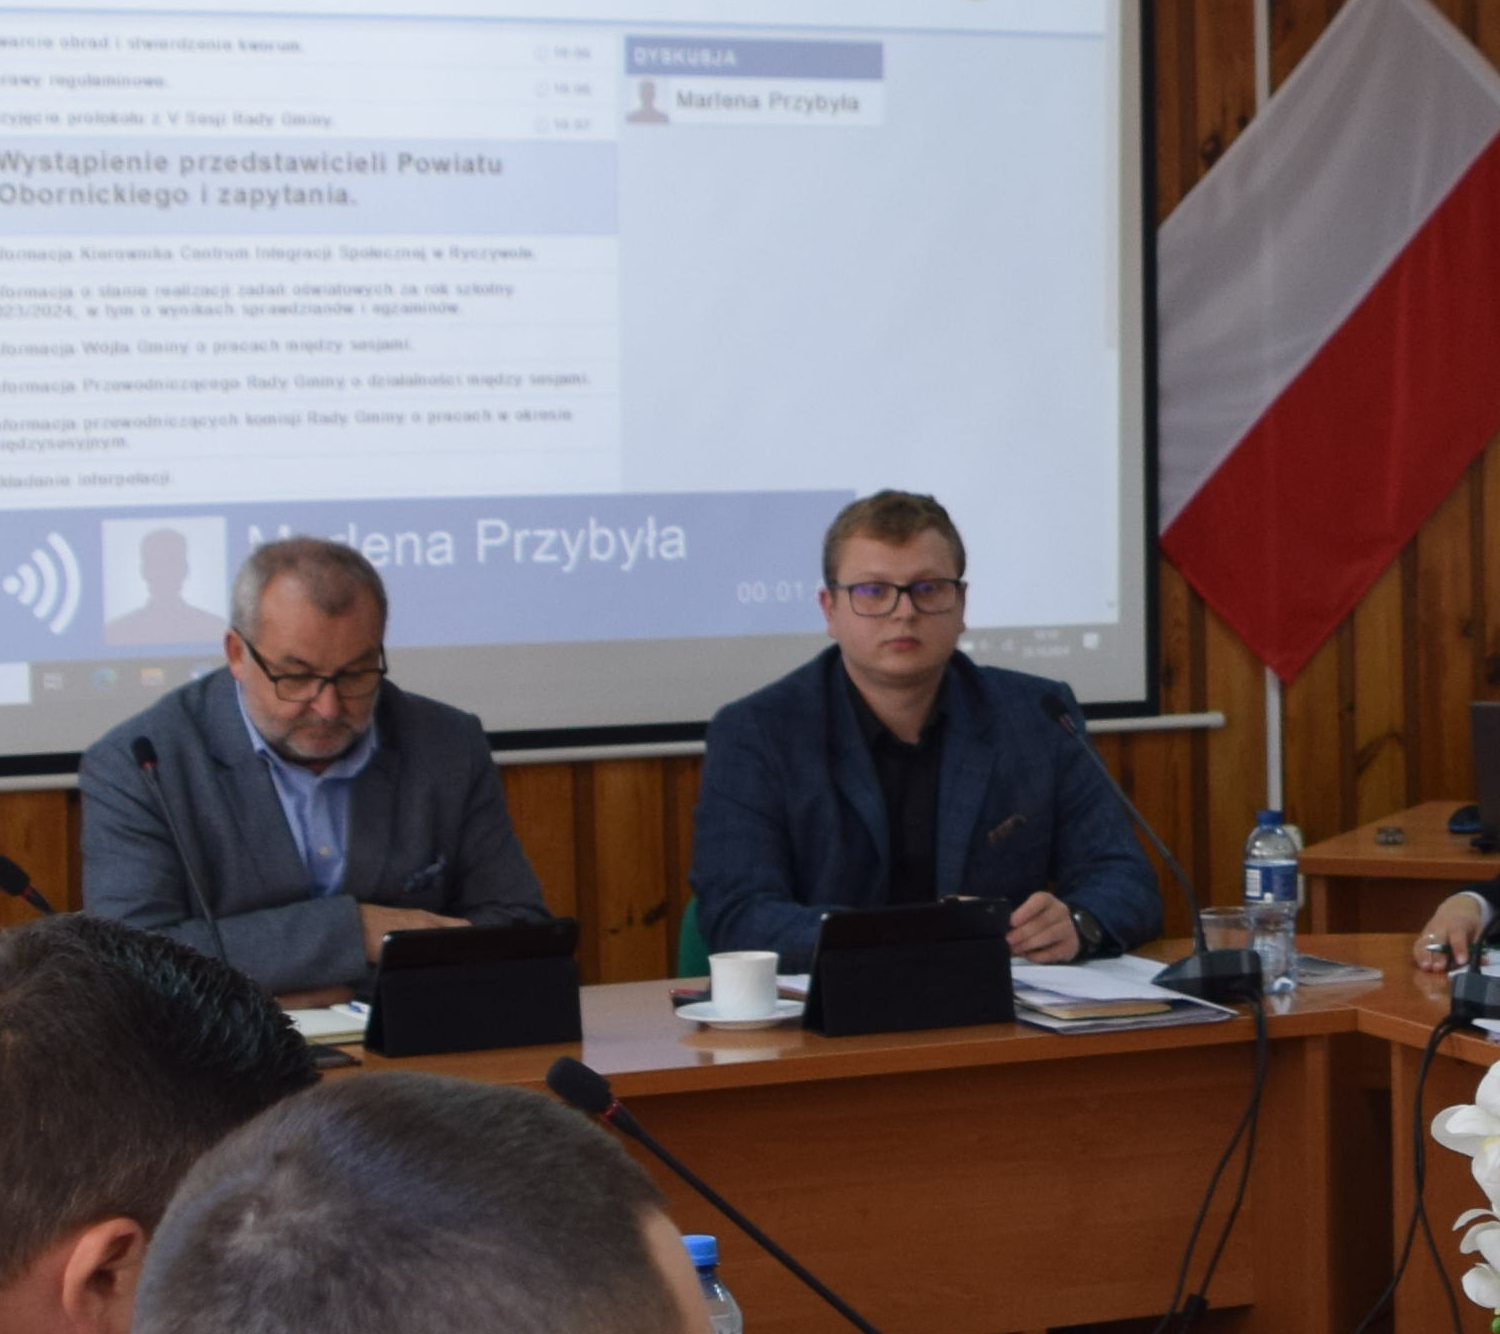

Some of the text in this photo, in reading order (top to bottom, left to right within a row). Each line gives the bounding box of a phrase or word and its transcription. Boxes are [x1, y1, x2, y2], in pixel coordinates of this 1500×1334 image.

[59, 35, 109, 50] obrad
[633, 46, 737, 67] DYSKUSJA
[676, 91, 861, 116] Marlena Przybyła
[179, 149, 387, 179] przedstawicieli
[398, 152, 501, 176] Powiatu
[217, 184, 358, 211] zapytania.
[474, 516, 688, 572] Przybyła
